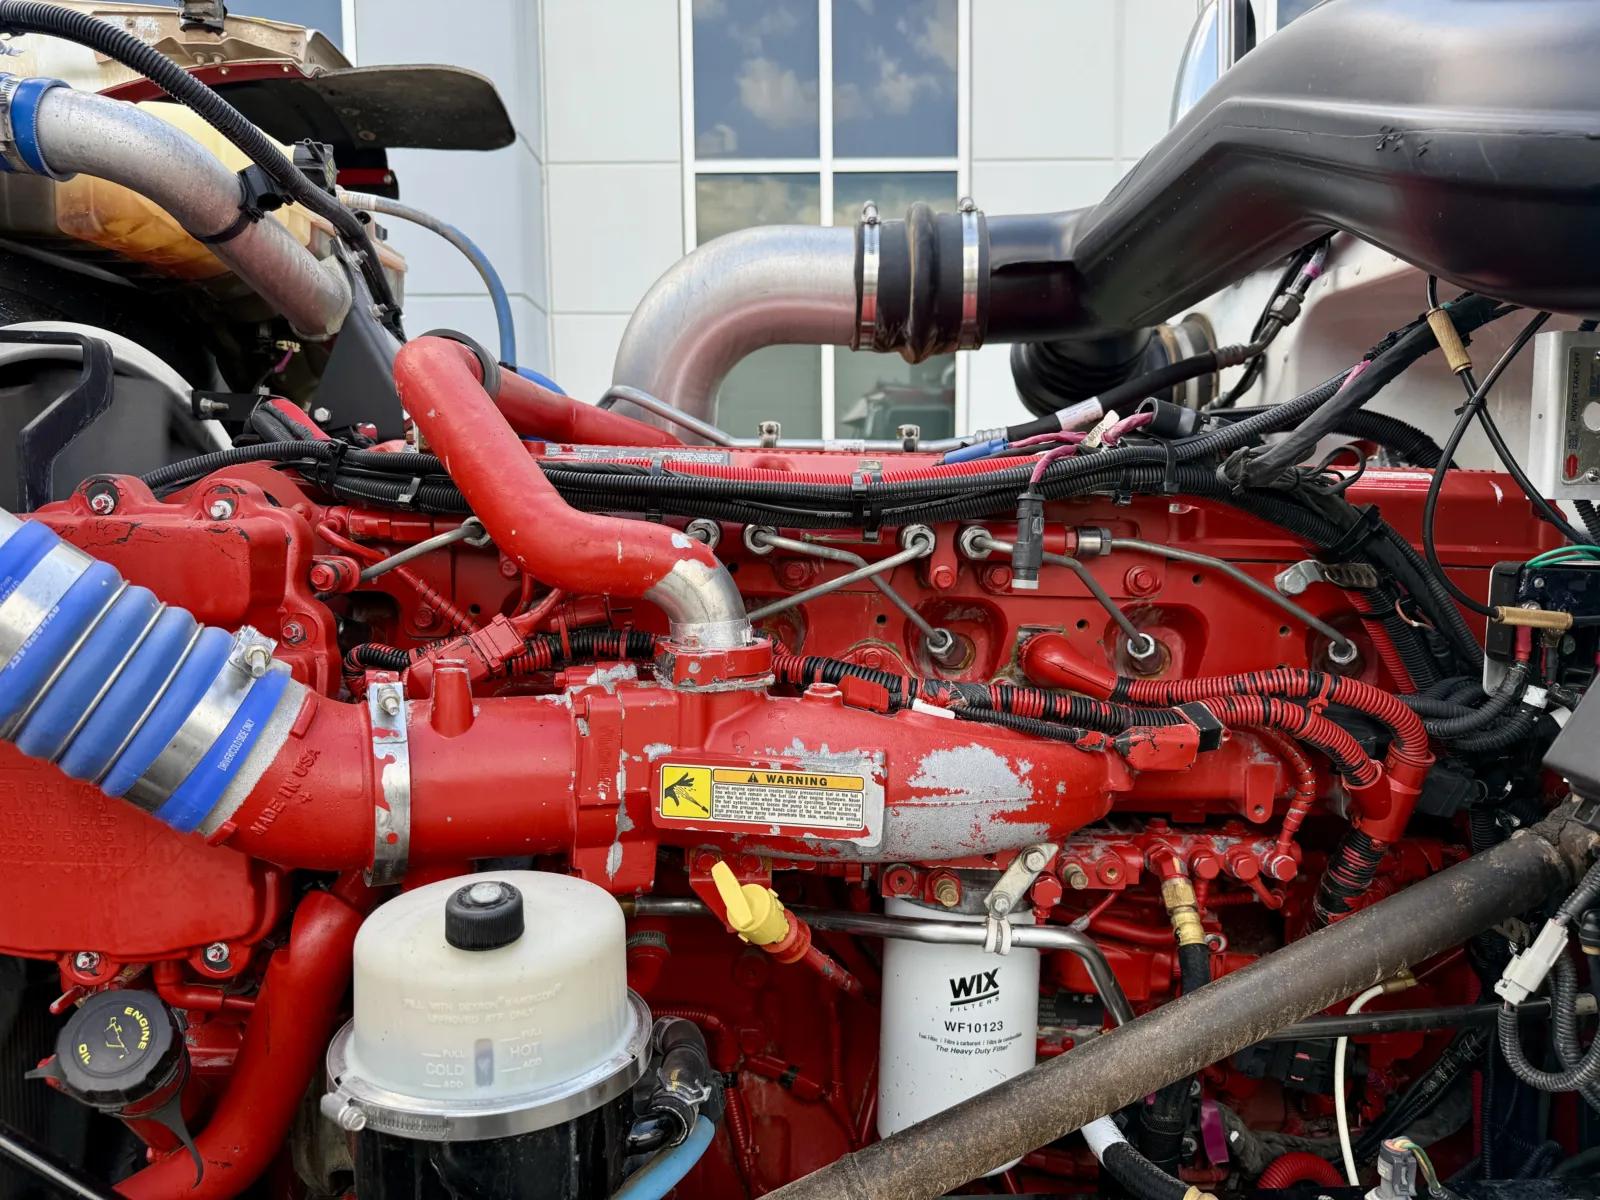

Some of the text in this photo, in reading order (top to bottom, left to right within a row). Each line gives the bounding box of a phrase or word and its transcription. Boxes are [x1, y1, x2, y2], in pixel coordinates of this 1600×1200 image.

[1570, 392, 1579, 422] POWER
[766, 774, 828, 786] WARNING
[26, 782, 61, 793] BOLT
[250, 748, 320, 835] MADE IN USA
[68, 815, 118, 826] ISSUED
[54, 829, 115, 842] PENDING
[950, 968, 999, 998] WIX
[950, 996, 999, 1012] FILTERS
[522, 1027, 543, 1038] FULL
[944, 1020, 1004, 1033] WF10123
[79, 1006, 150, 1065] ENGINE OIL
[442, 1048, 464, 1058] FULL
[510, 1041, 541, 1057] HOT
[425, 1062, 464, 1076] COLD
[523, 1057, 543, 1068] ADD
[443, 1080, 464, 1088] ADD
